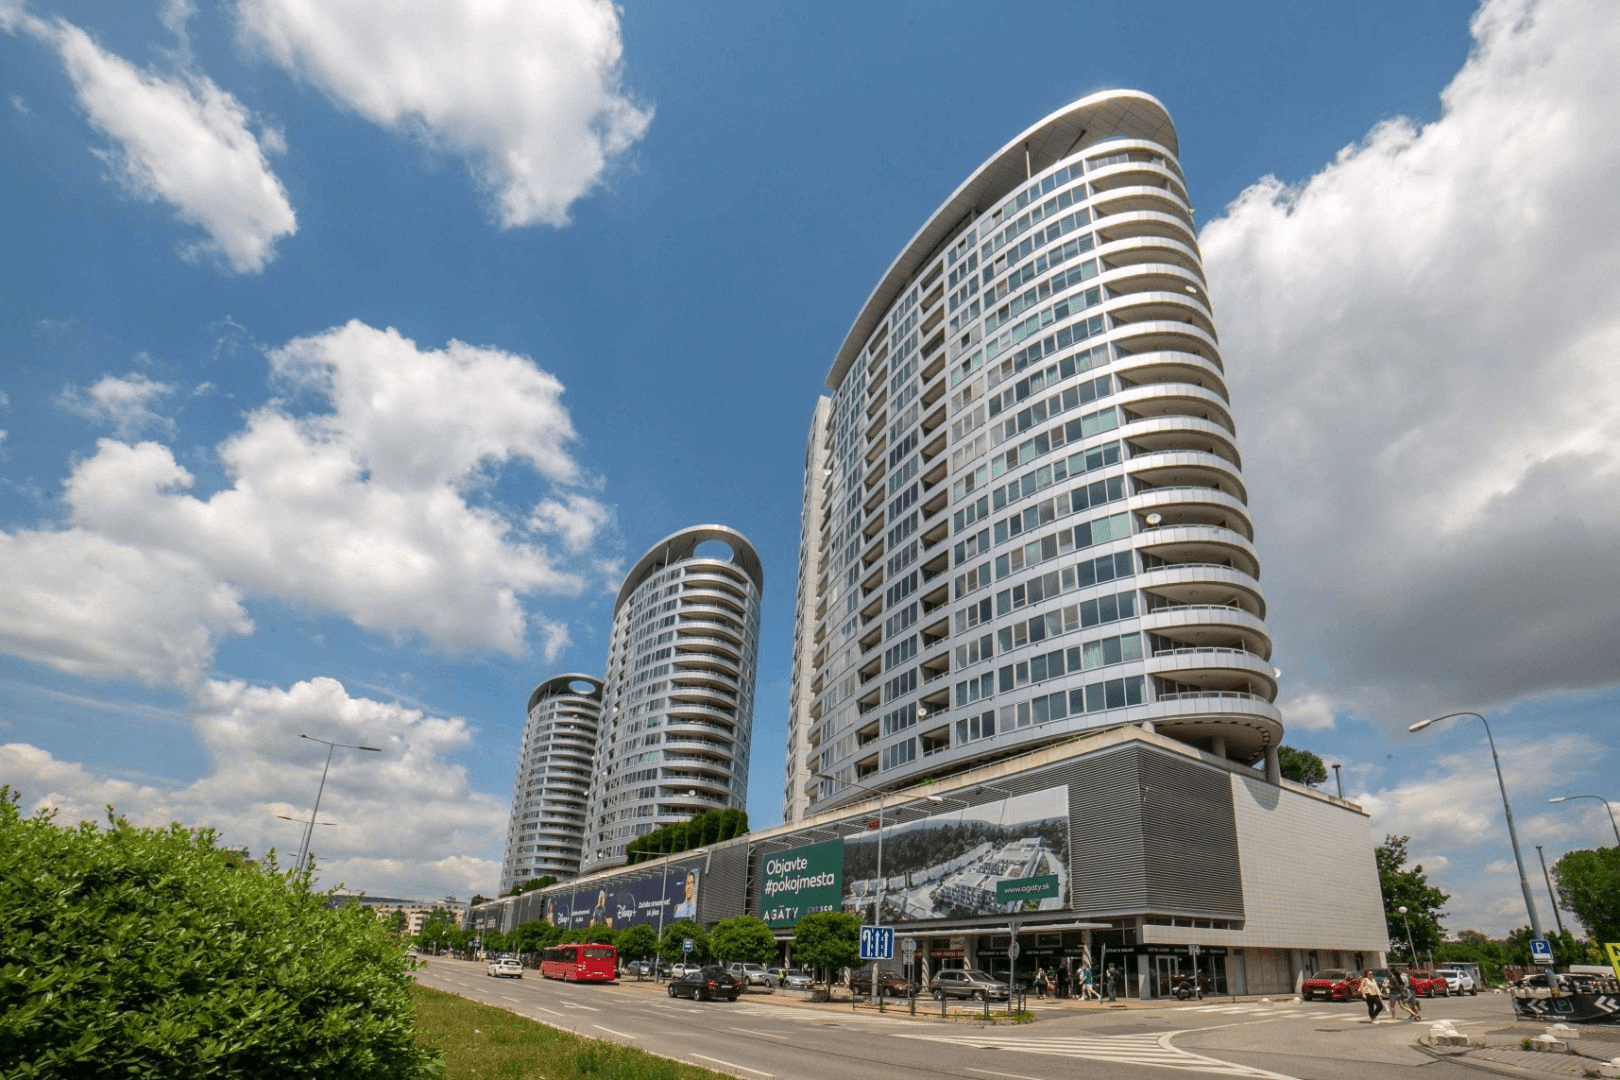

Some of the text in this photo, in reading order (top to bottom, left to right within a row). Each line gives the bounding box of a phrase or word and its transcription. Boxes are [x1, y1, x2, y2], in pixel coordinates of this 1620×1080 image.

[766, 856, 808, 878] Objavte
[764, 871, 835, 897] #pokojmesta
[1535, 942, 1545, 953] P
